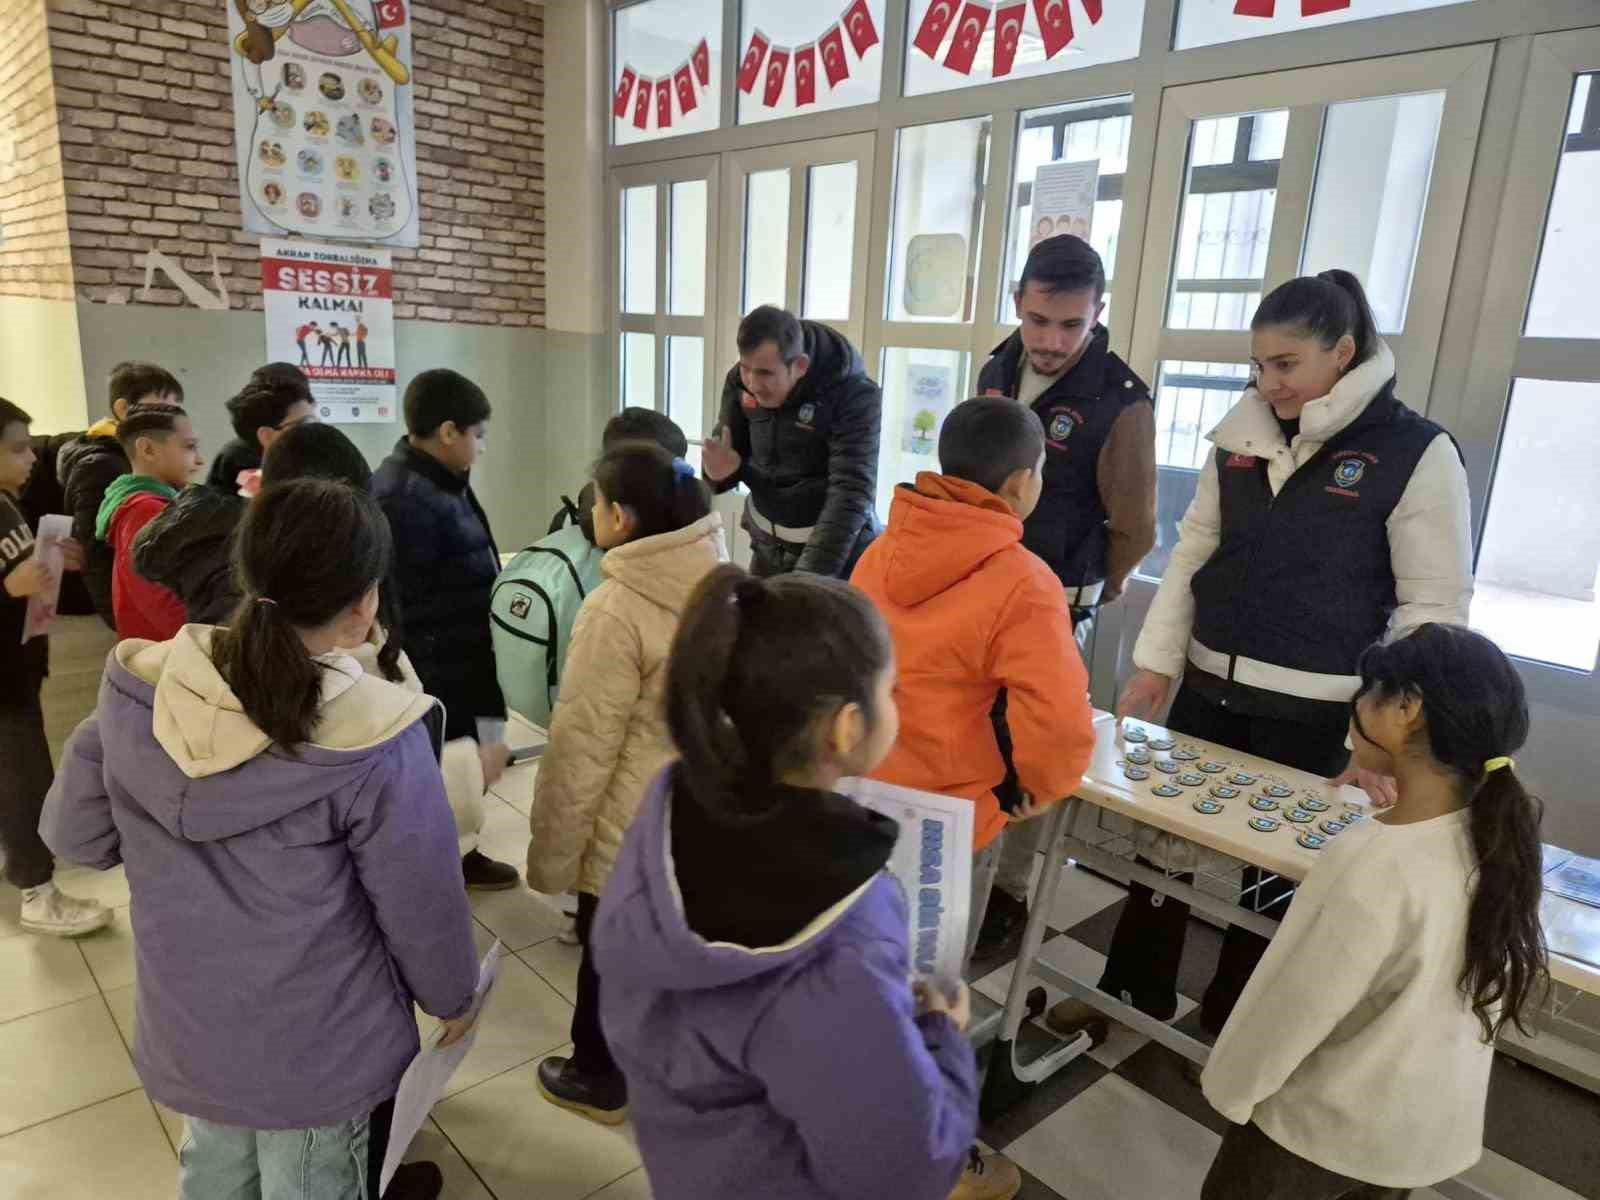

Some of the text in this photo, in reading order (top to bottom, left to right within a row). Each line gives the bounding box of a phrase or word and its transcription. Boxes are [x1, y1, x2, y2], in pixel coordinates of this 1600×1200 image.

[276, 248, 311, 258] AKRAN
[279, 267, 379, 296] SESSİZ
[298, 296, 363, 312] KALMA!
